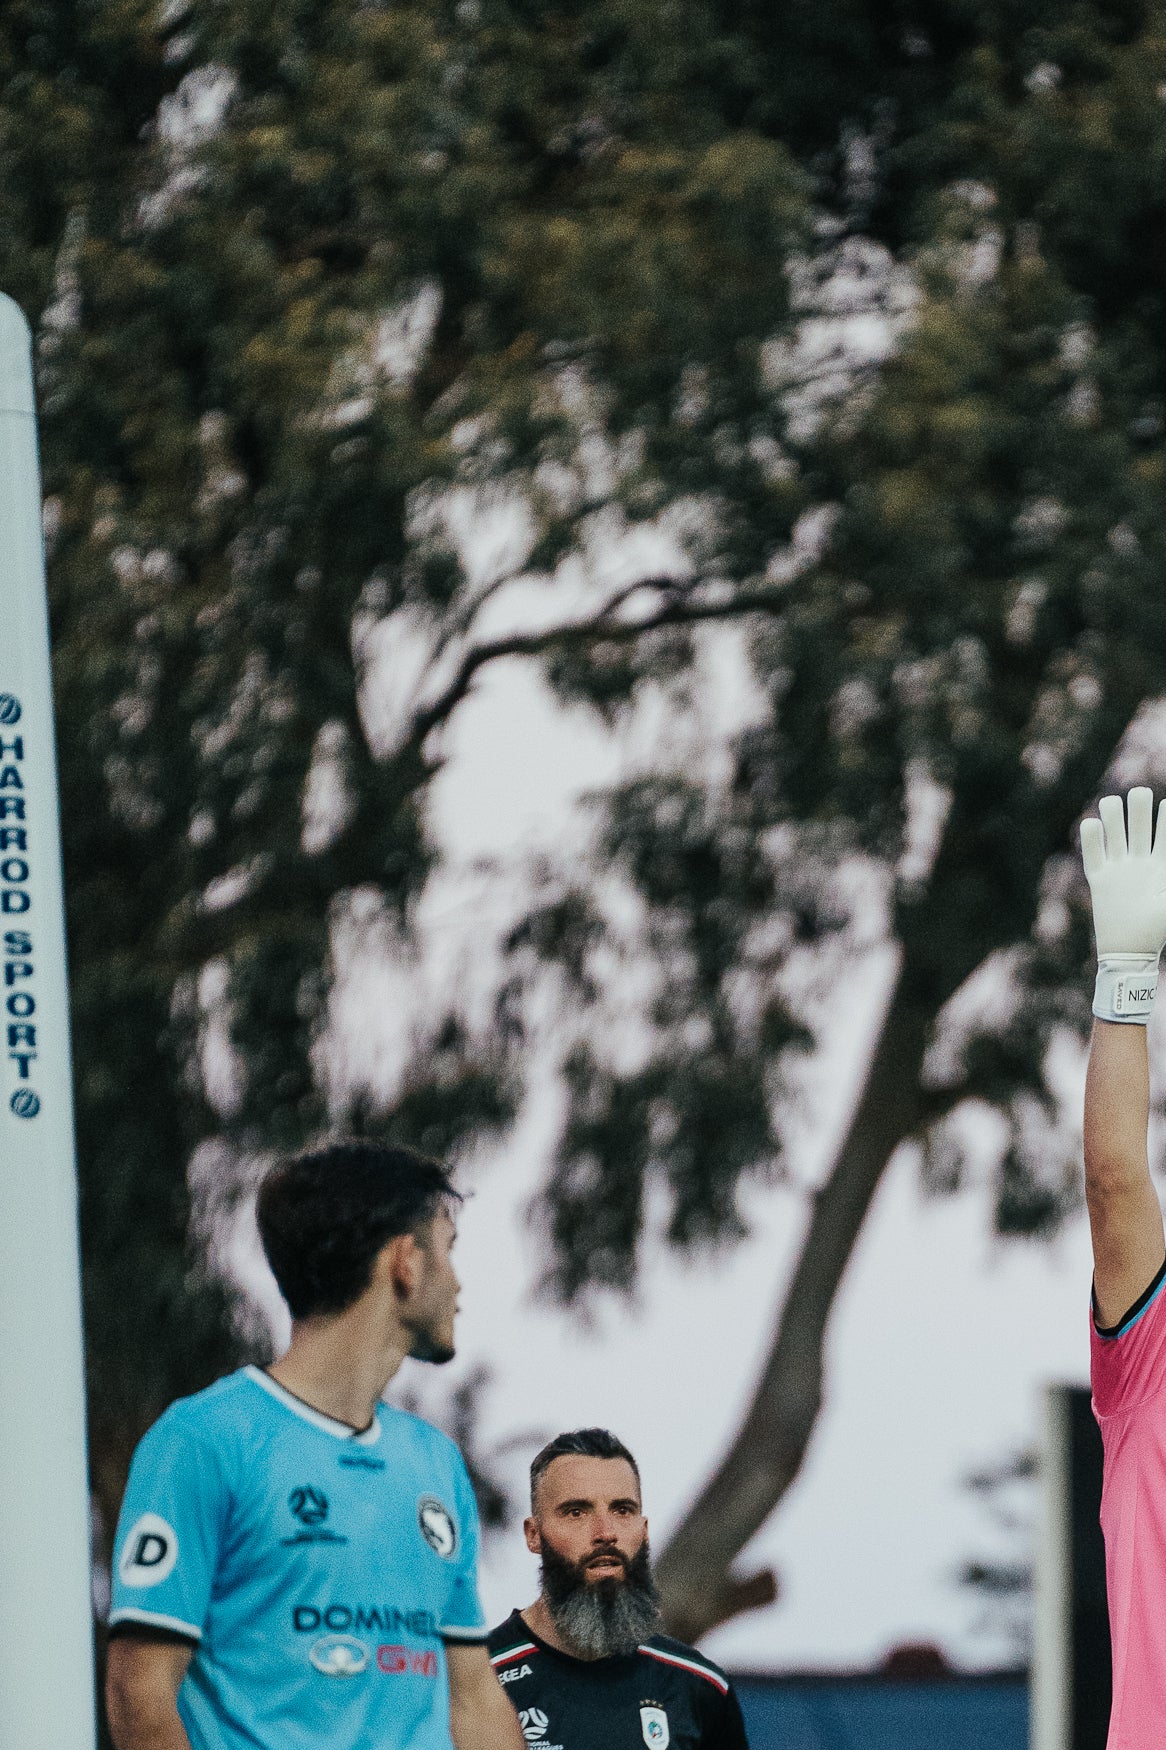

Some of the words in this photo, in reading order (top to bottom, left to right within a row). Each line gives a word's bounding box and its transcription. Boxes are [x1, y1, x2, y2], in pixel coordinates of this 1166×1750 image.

[0, 735, 30, 913] HARROD
[4, 930, 37, 1079] SPORT
[498, 1664, 533, 1687] EGEA
